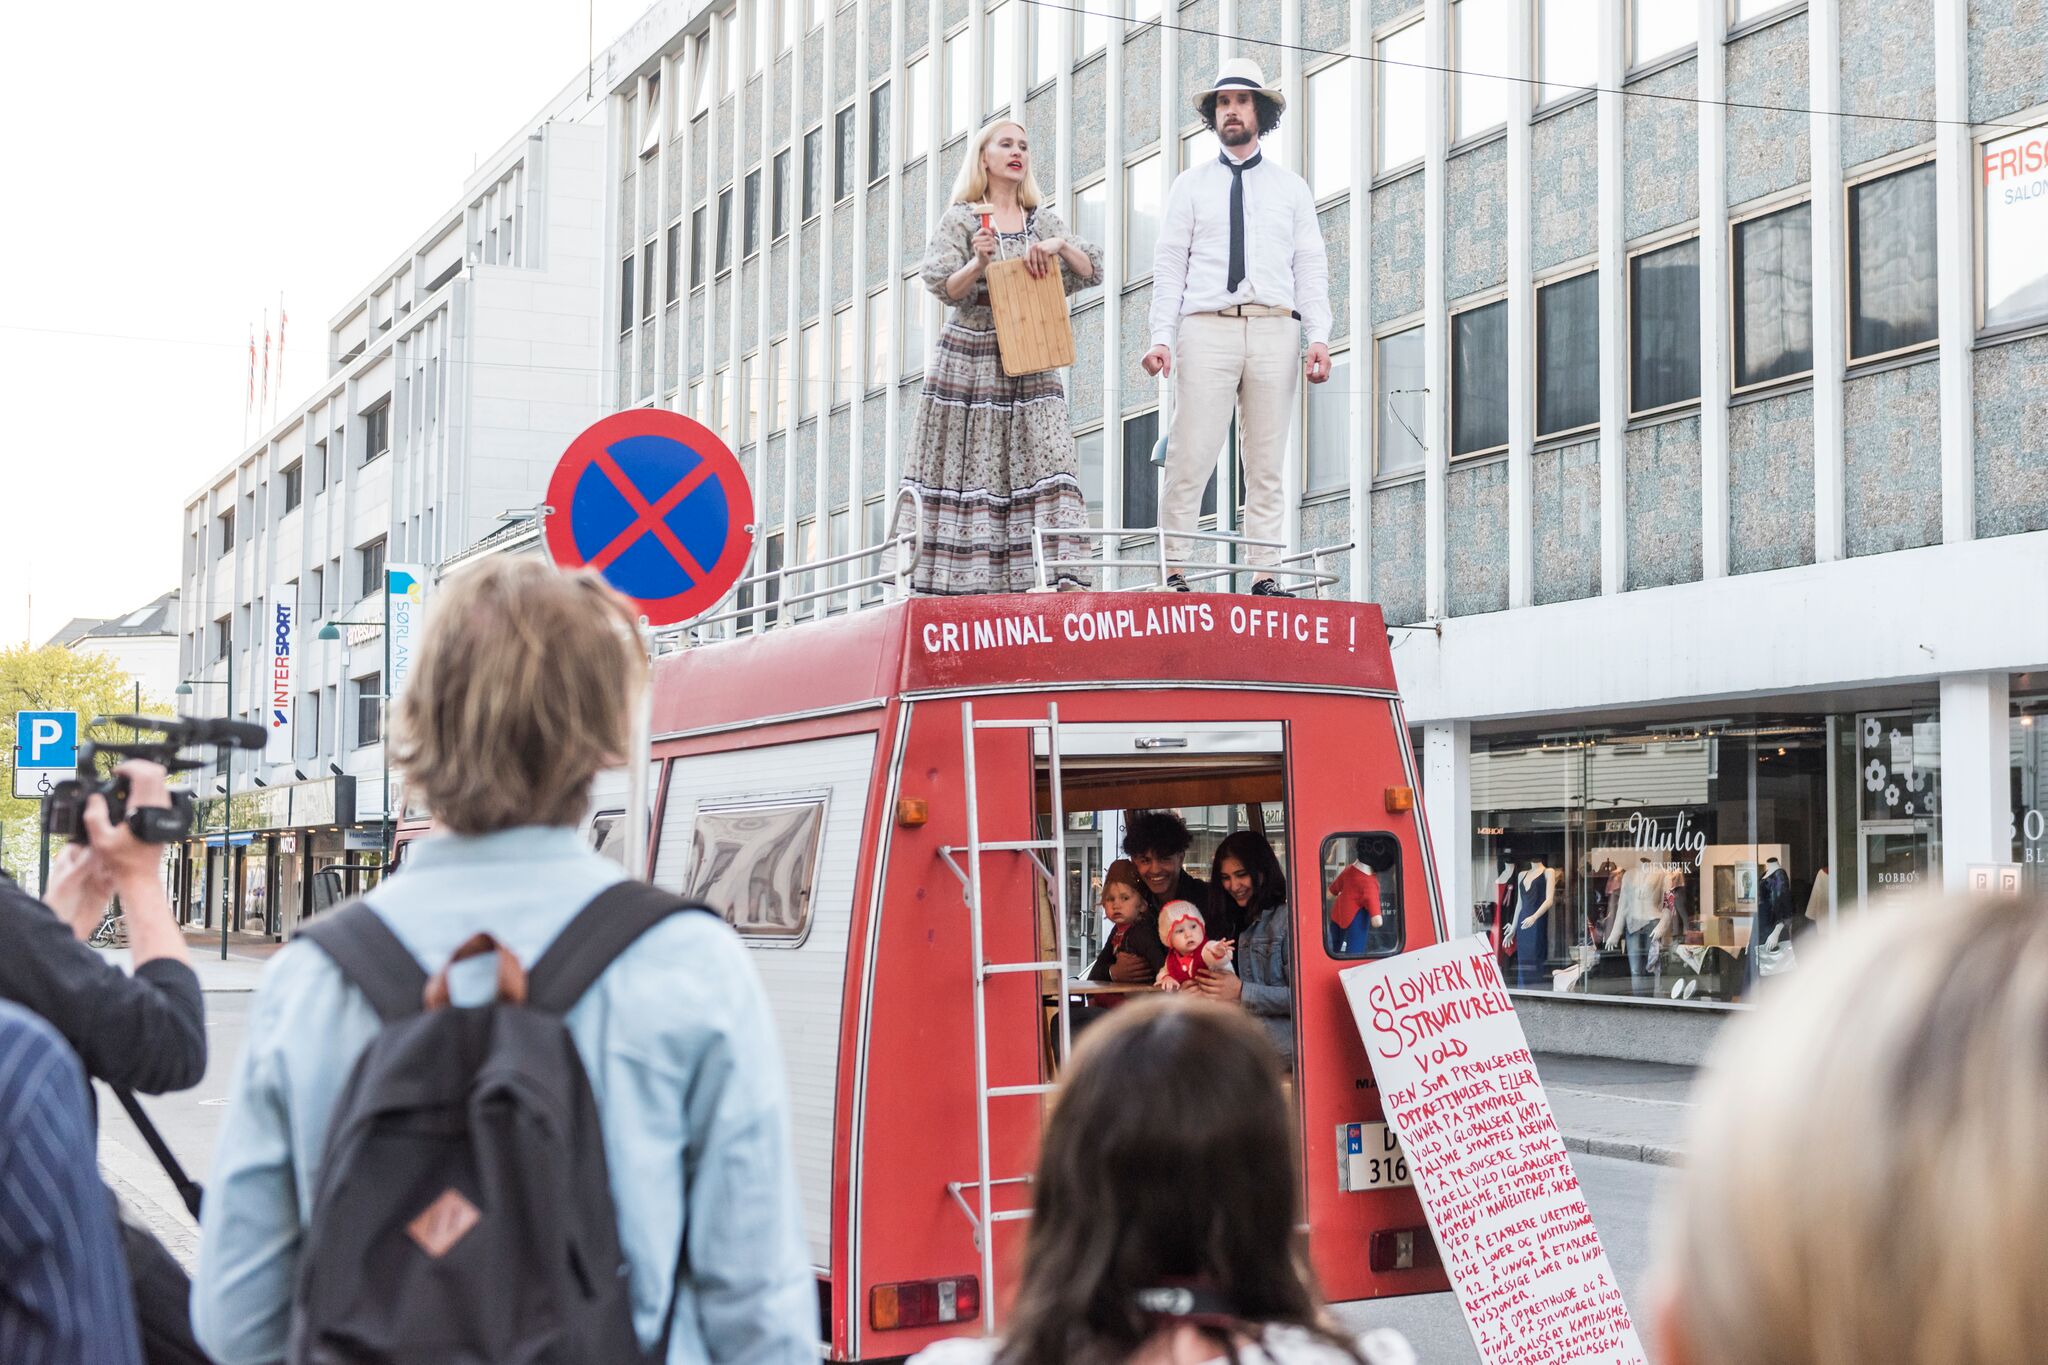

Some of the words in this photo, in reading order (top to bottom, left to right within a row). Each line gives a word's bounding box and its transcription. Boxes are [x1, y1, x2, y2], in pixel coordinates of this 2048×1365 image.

[1983, 141, 2048, 187] FRIS
[923, 614, 1052, 653] CRIMINAL
[1063, 603, 1215, 643] COMPLAINTS
[1230, 606, 1329, 644] OFFICE
[273, 603, 291, 707] INTERSPORT
[31, 718, 63, 761] P
[1628, 810, 1708, 867] Mulig
[1384, 960, 1471, 1011] LOVVERK
[1469, 951, 1501, 993] MOT
[1399, 988, 1515, 1049] STRUKTURELL
[1414, 1037, 1468, 1074] VOLD
[1388, 1082, 1418, 1110] DEN
[1421, 1074, 1450, 1097] SOM
[1450, 1048, 1532, 1081] PRODUSERER
[1498, 1069, 1539, 1091] ELLER
[1403, 1119, 1443, 1147] VINNER
[1462, 1091, 1526, 1120] STRUKTURELL
[1411, 1141, 1441, 1163] VOLD
[1445, 1134, 1453, 1147] I
[1453, 1110, 1514, 1144] GLOBALISERT
[1351, 1143, 1359, 1151] N
[1415, 1148, 1461, 1180] TALISME
[1466, 1128, 1514, 1155] STRAFFES
[1437, 1173, 1450, 1190] Å
[1448, 1148, 1516, 1184] PRODUSERE
[1427, 1185, 1471, 1213] TURELL
[1472, 1171, 1498, 1189] VOLD
[1497, 1182, 1511, 1195] ET
[1440, 1209, 1476, 1244] NOMEN
[1447, 1233, 1469, 1250] VED
[1474, 1235, 1485, 1254] Å
[1485, 1217, 1537, 1247] ETABLERE
[1453, 1263, 1479, 1283] SIGE
[1482, 1243, 1515, 1267] LOVER
[1517, 1237, 1531, 1248] OG
[1490, 1264, 1500, 1284] Å
[1502, 1251, 1537, 1276] UNNGÅ
[1540, 1244, 1551, 1261] Å
[1465, 1272, 1530, 1313] RETTMESSIGE
[1534, 1261, 1562, 1279] LOVER
[1566, 1254, 1579, 1265] OG
[1511, 1287, 1577, 1328] OPPRETTHOLDE
[1583, 1281, 1596, 1293] OG
[1598, 1274, 1609, 1286] Å
[1484, 1332, 1515, 1356] VINNE
[1520, 1317, 1535, 1337] PÅ
[1537, 1297, 1596, 1331] STRUKTURELL
[1598, 1289, 1620, 1305] VOLD
[1498, 1326, 1563, 1365] GLOBALISERT
[1555, 1326, 1605, 1350] FENOMEN
